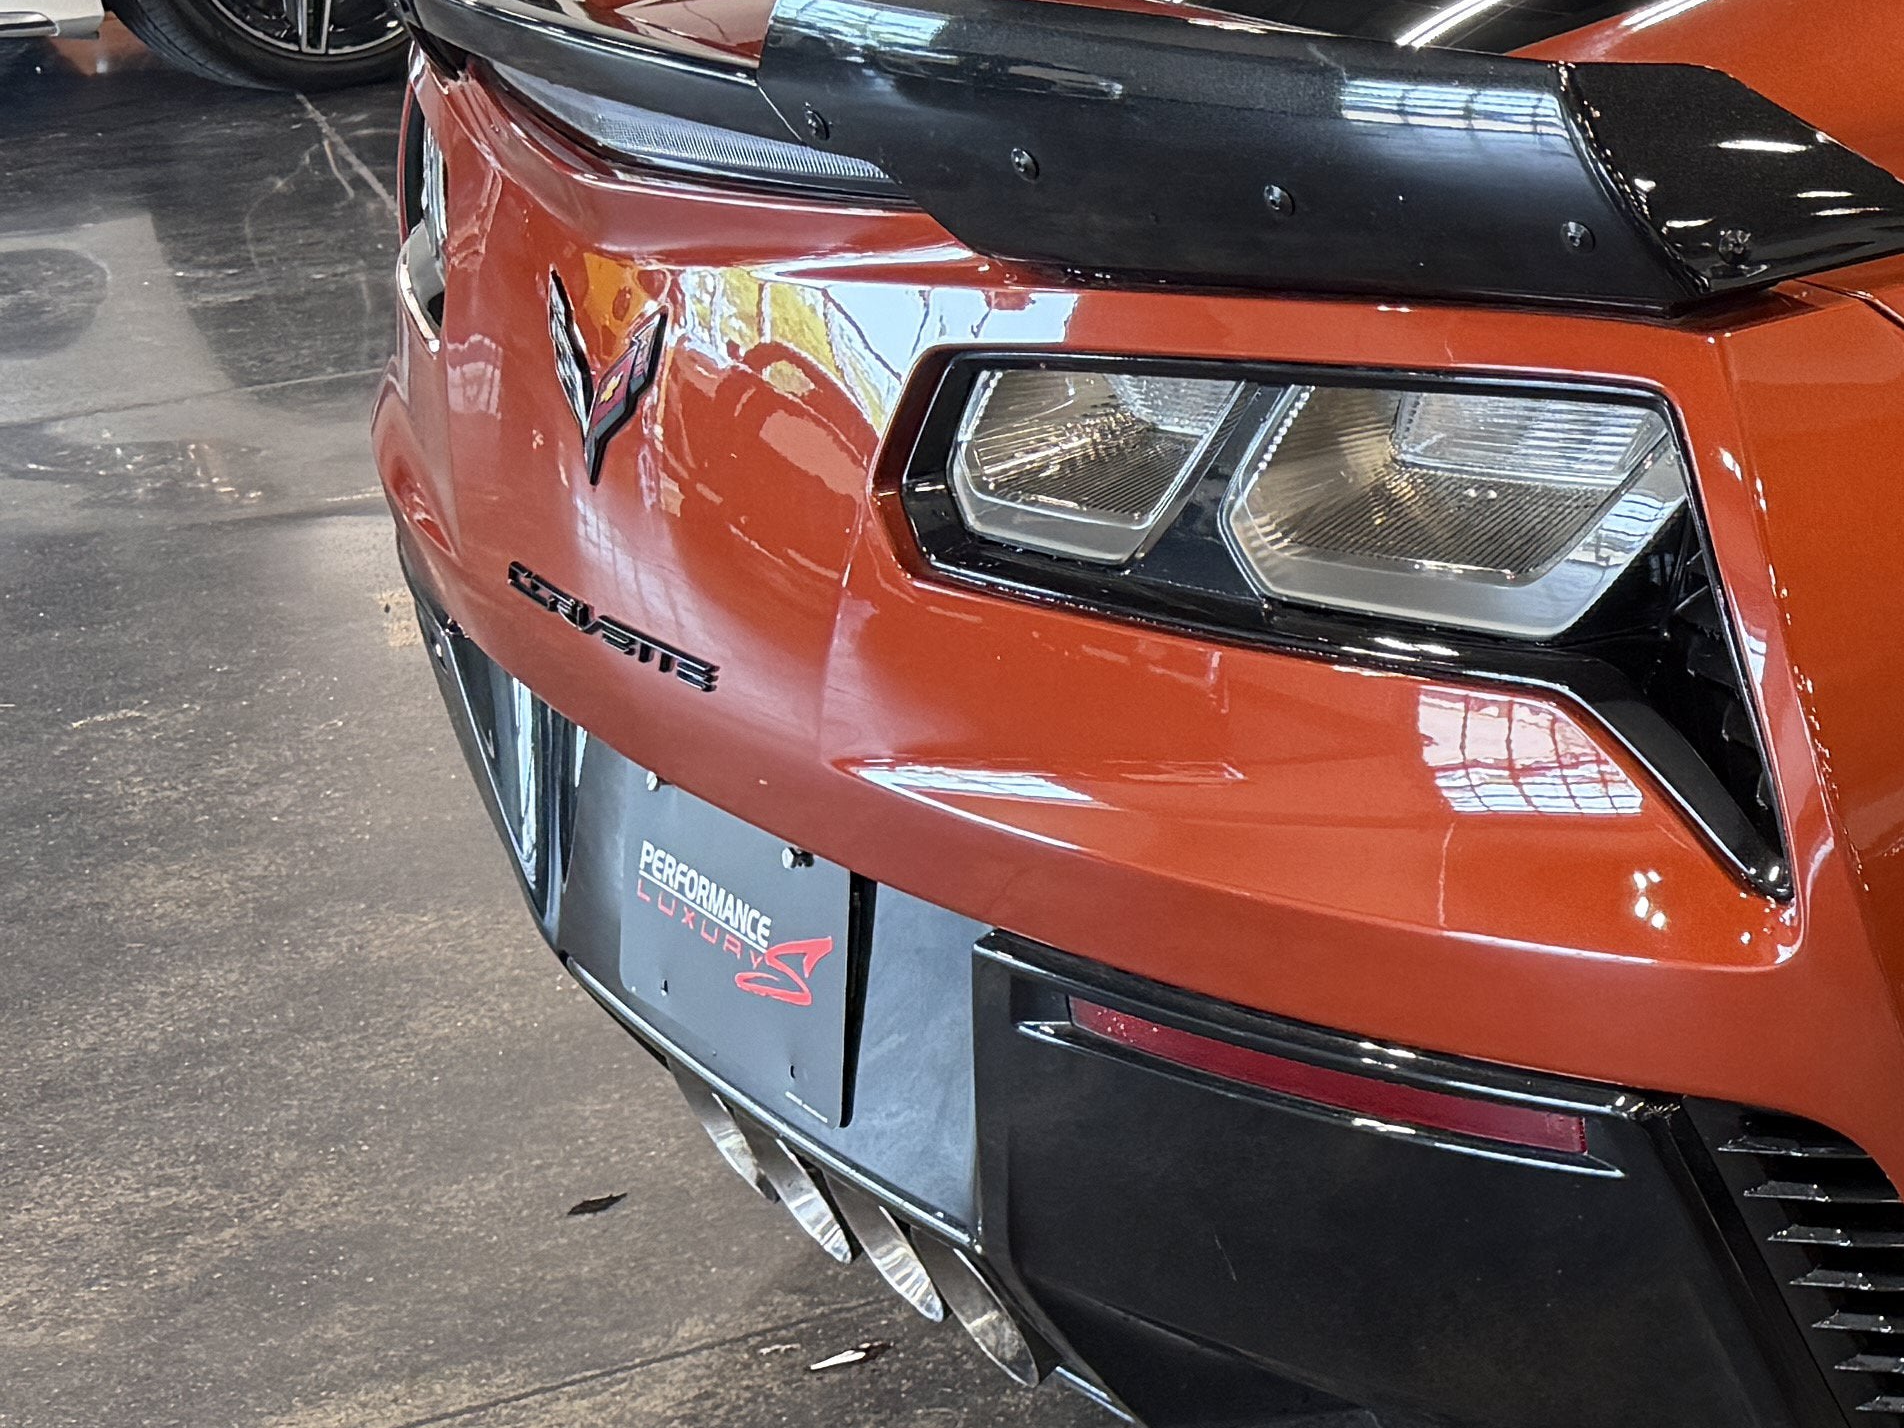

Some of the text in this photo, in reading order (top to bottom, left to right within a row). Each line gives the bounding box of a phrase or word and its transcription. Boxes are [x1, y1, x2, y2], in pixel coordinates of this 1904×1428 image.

[508, 561, 720, 692] CORVETTE
[636, 878, 764, 970] LUXURY
[638, 839, 772, 948] PERFORMANCE
